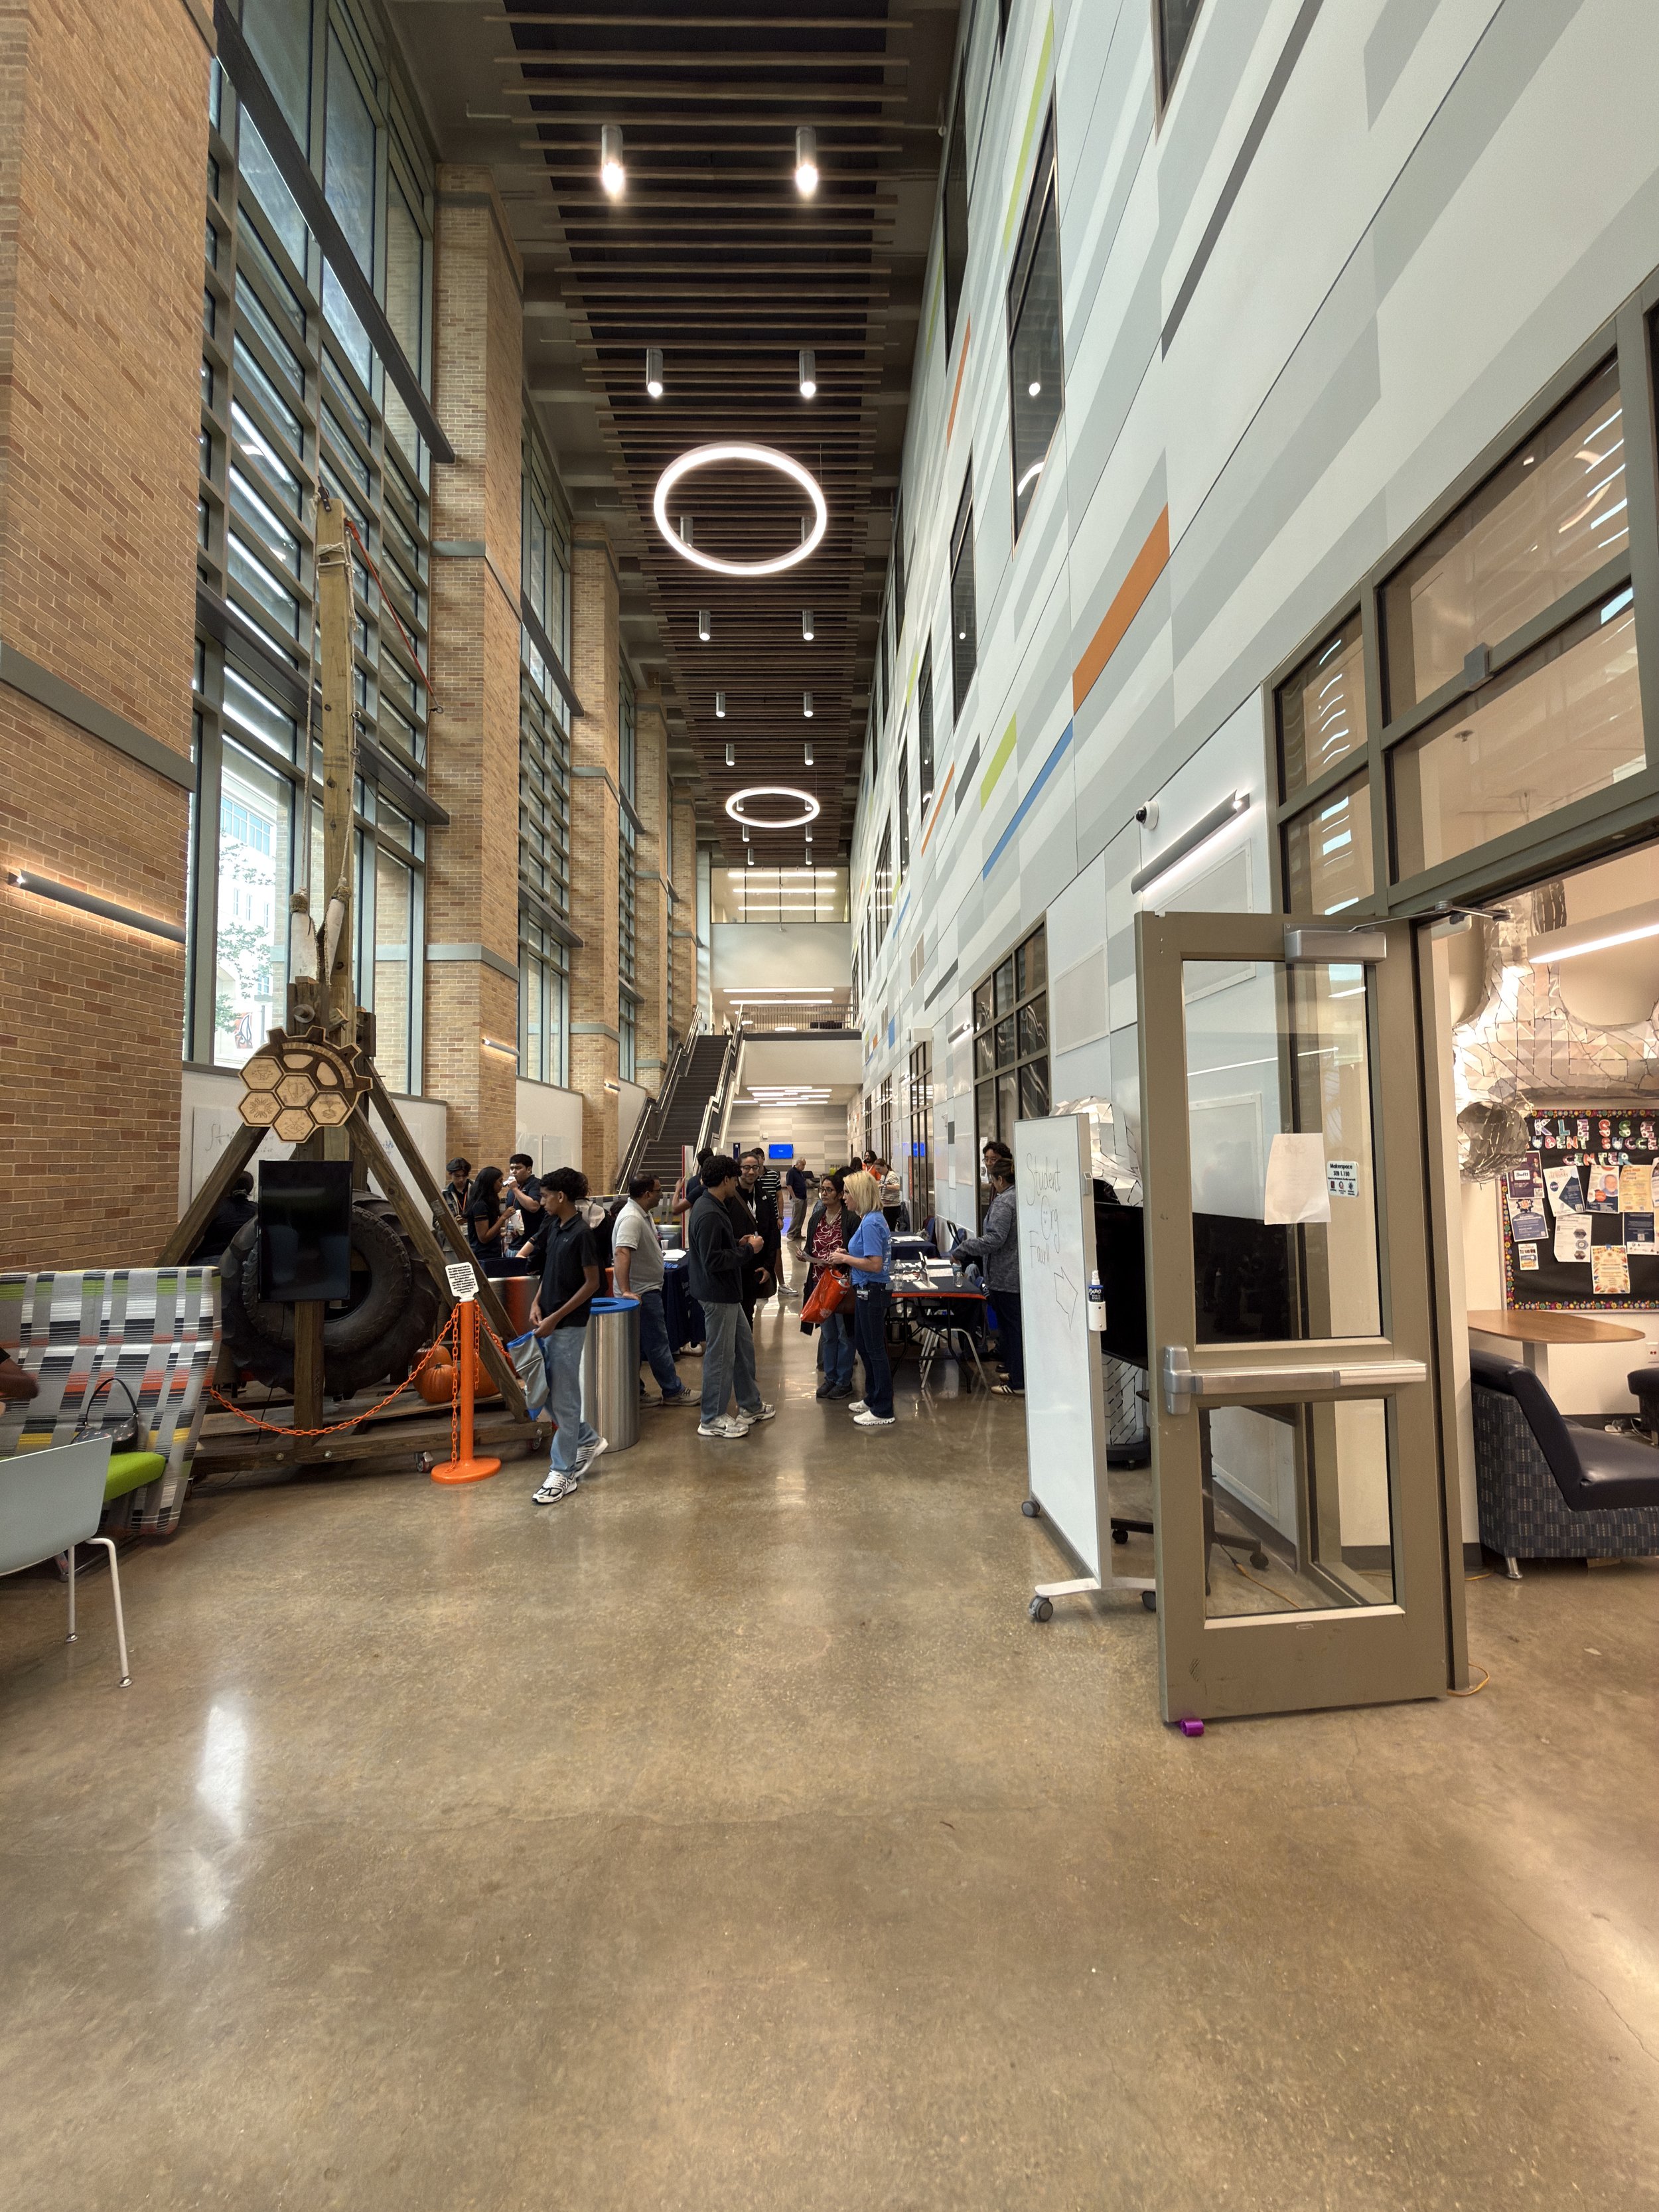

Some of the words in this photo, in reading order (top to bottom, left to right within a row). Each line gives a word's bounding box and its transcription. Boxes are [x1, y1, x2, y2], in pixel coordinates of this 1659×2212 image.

[1534, 1118, 1656, 1138] KLESSE
[1526, 1136, 1587, 1149] UDENT
[1601, 1137, 1659, 1150] SUCCE
[1562, 1151, 1632, 1166] CENTER
[1026, 1152, 1060, 1206] Student
[1041, 1195, 1060, 1254] Org
